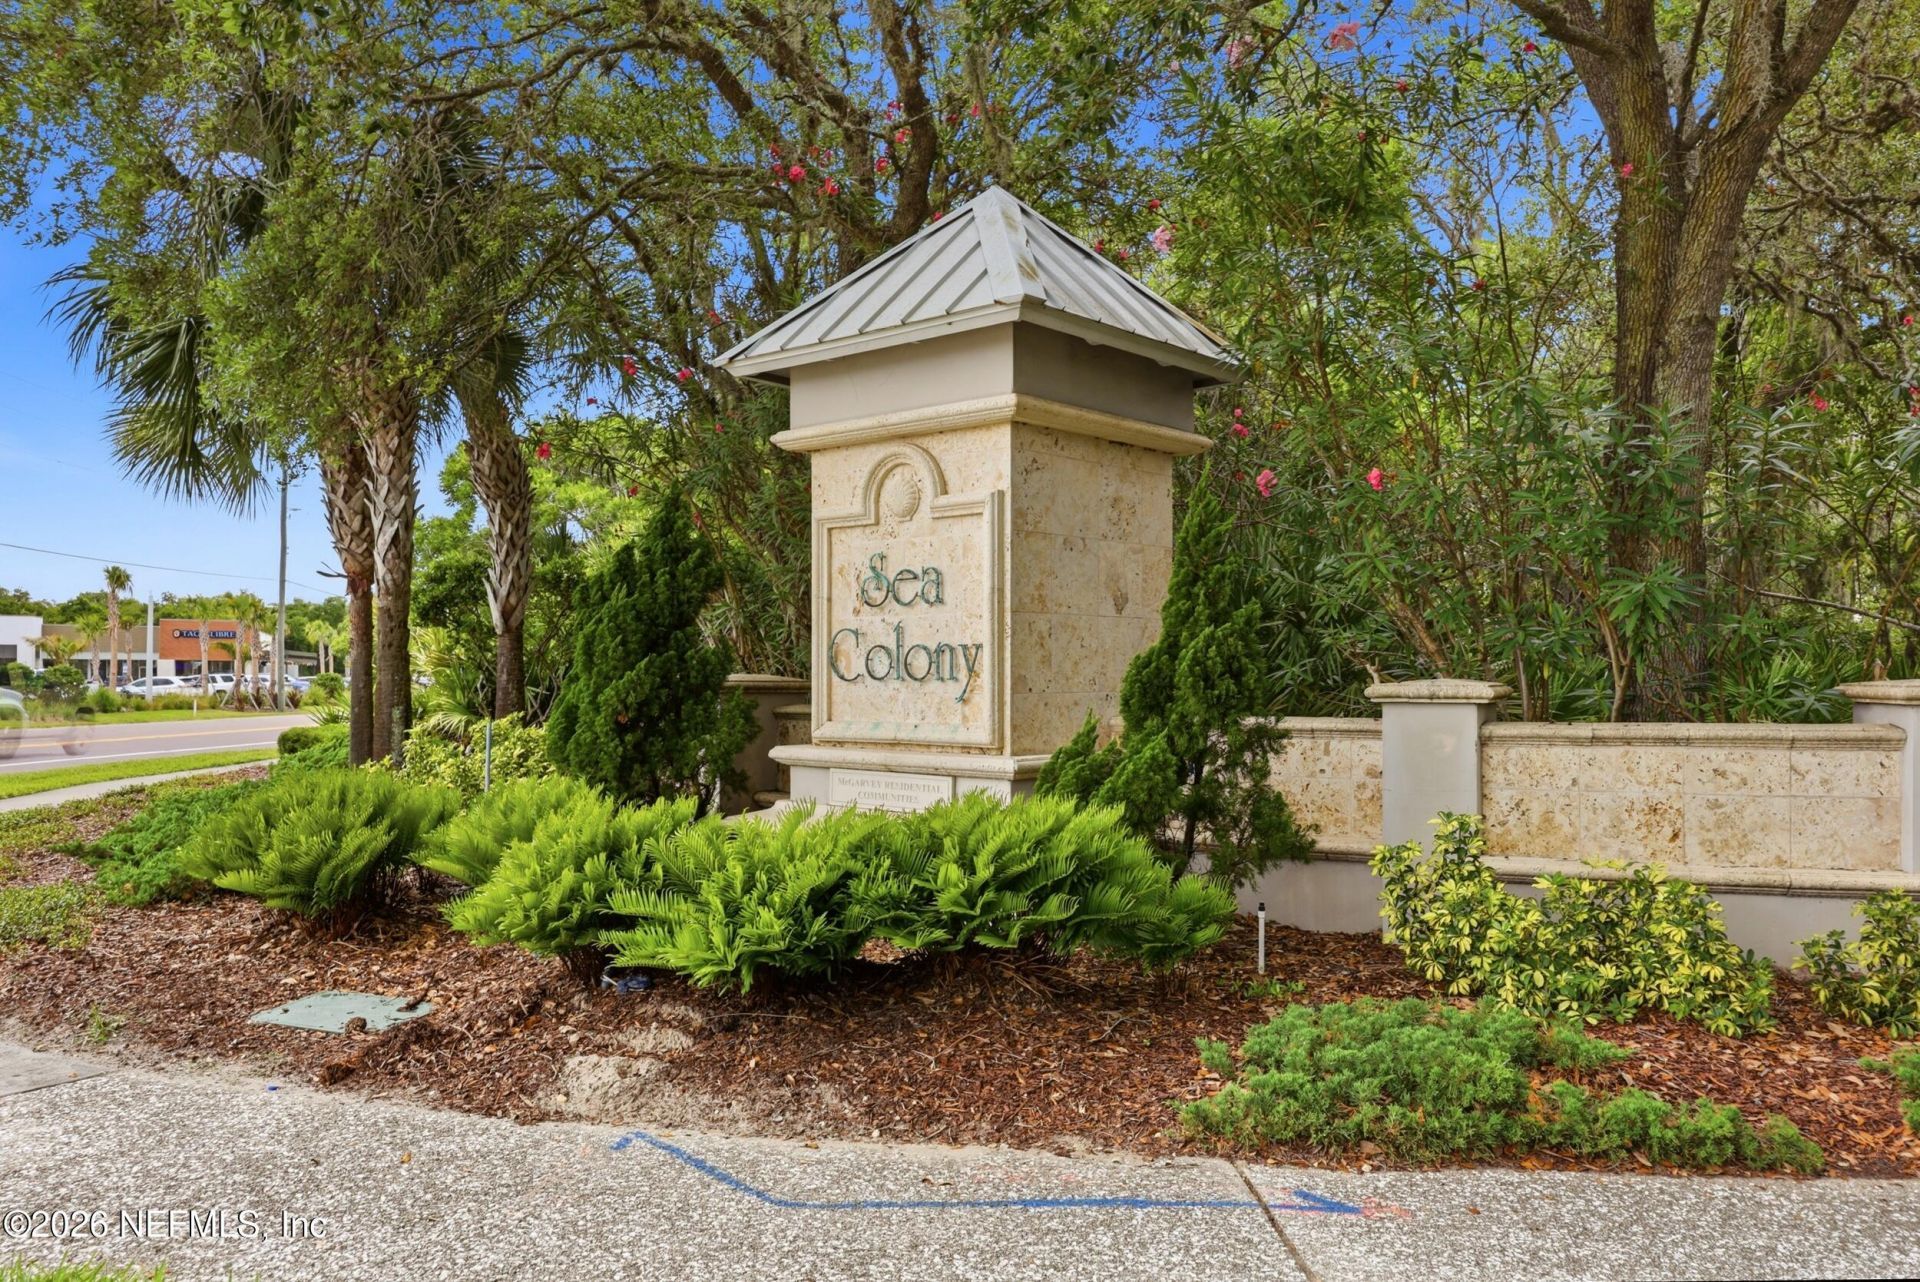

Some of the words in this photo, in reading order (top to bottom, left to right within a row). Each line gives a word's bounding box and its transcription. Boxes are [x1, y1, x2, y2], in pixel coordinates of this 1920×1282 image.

[861, 551, 944, 607] Sea
[183, 630, 203, 638] TAC
[211, 630, 236, 638] LIBRE
[829, 621, 983, 703] Colony
[885, 781, 941, 793] RESIDENTIAL
[858, 791, 918, 803] COMMUNITIES
